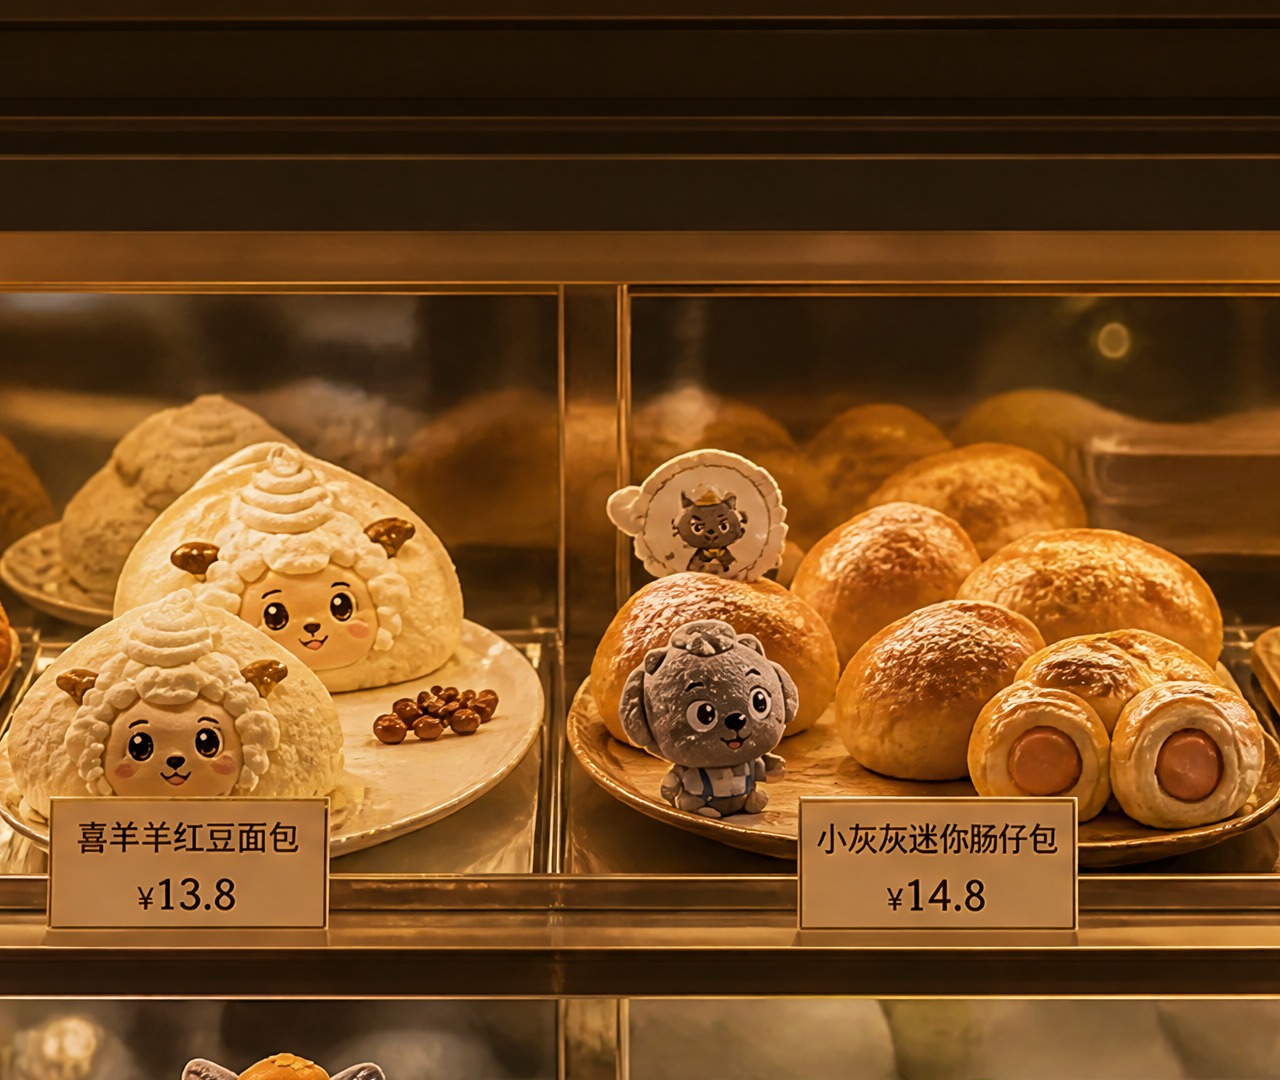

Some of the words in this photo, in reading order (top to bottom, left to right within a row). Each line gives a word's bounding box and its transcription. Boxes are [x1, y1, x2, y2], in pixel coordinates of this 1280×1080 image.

[77, 820, 299, 855] 喜羊羊红豆面包
[816, 822, 1058, 855] 小灰灰迷你肠仔包
[137, 877, 236, 911] ¥13.8
[886, 878, 986, 912] ¥14.8
